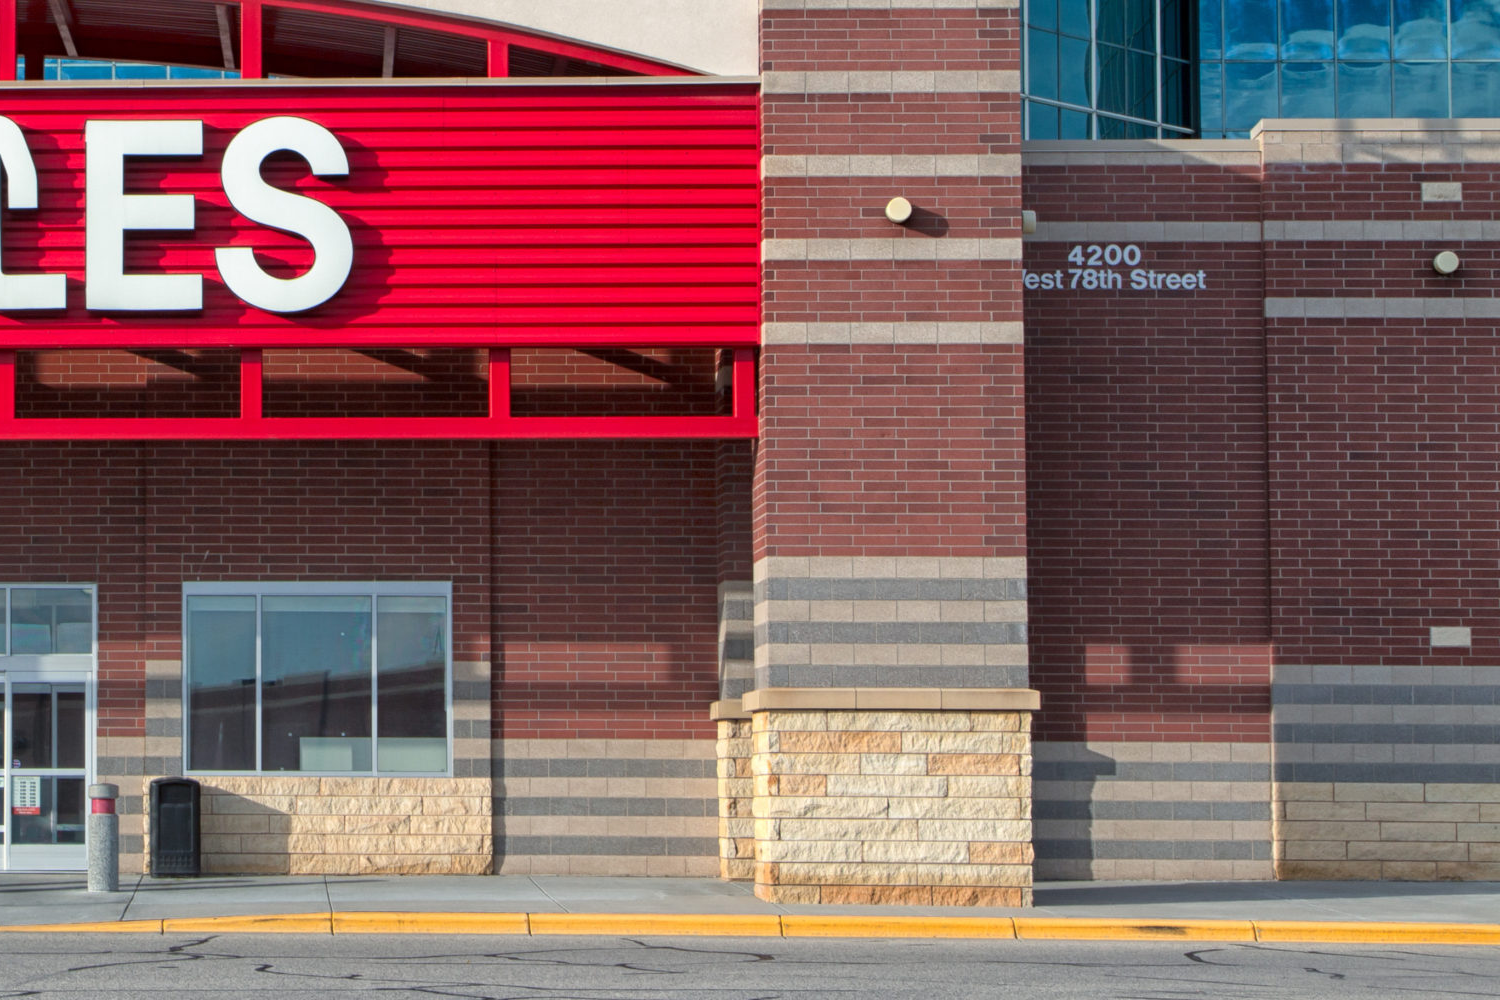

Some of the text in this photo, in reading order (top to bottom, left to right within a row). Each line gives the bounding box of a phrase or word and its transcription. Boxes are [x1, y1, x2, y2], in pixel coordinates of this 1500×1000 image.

[1068, 244, 1141, 266] 4200
[1022, 269, 1206, 290] est 78th Street
